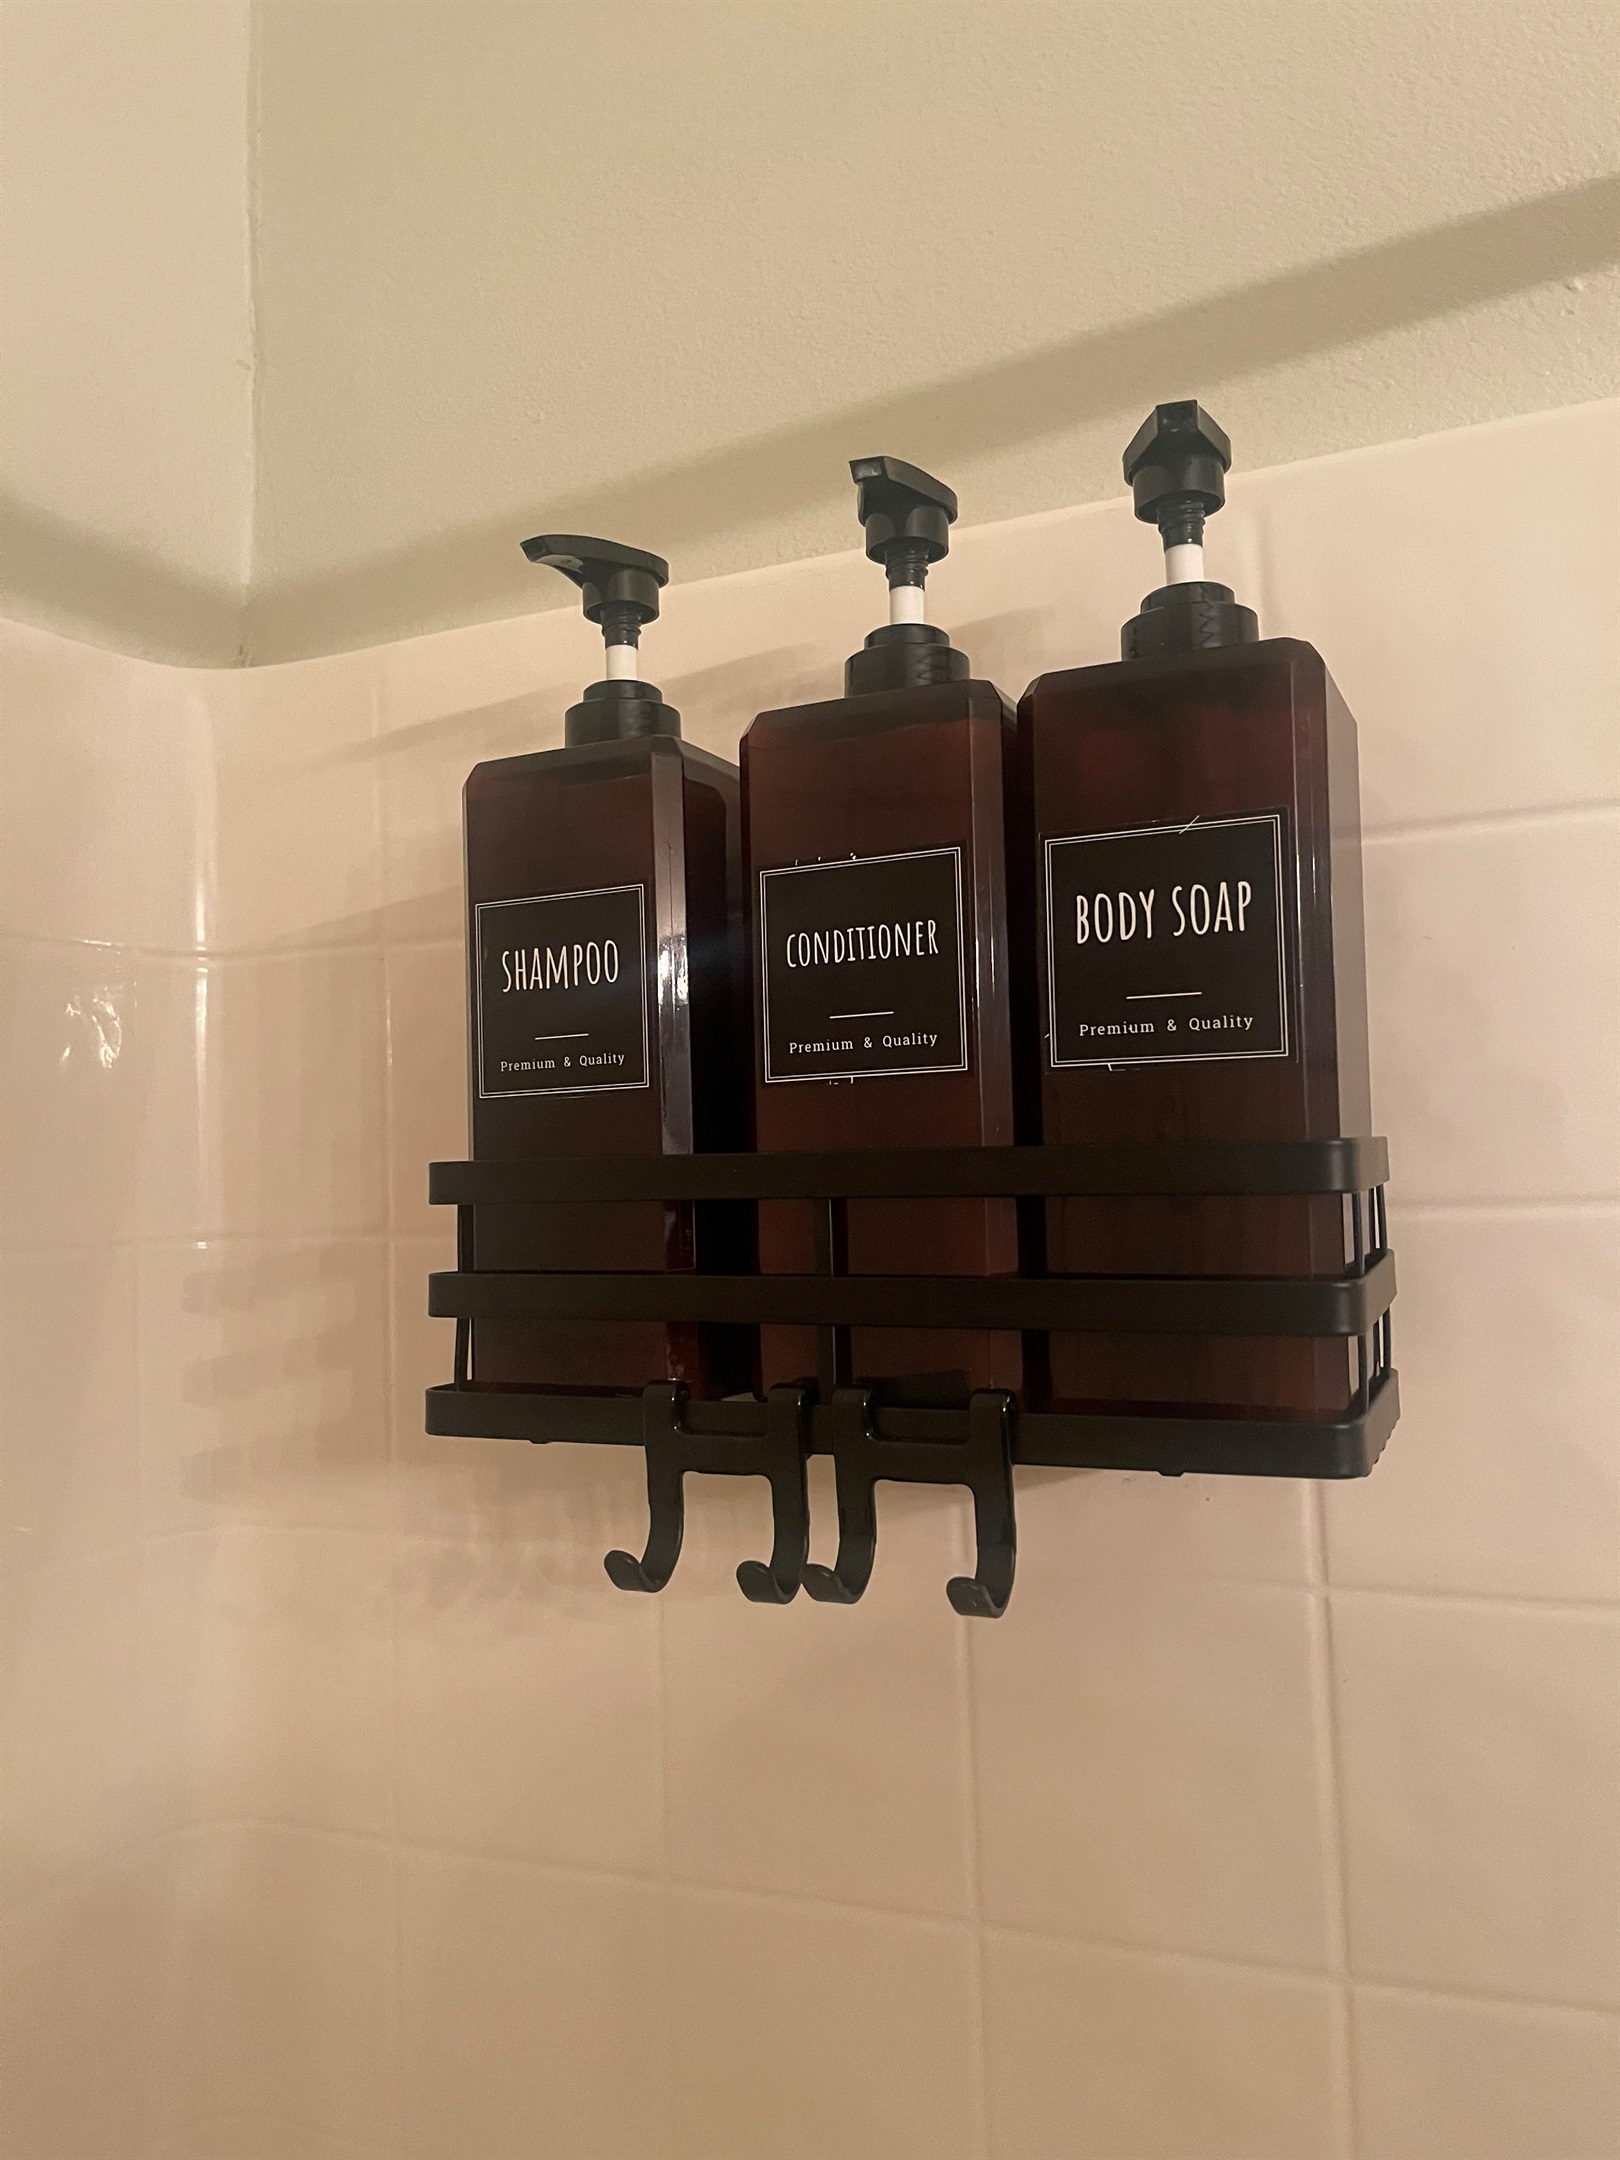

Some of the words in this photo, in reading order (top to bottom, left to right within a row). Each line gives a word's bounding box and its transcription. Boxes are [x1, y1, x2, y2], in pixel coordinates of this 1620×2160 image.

[1076, 888, 1155, 945] BODY
[1171, 880, 1252, 937] SOAP
[786, 919, 939, 969] CONDITIONER
[501, 939, 620, 993] SHAMPOO
[789, 1039, 854, 1054] Premium
[863, 1036, 873, 1049] &
[882, 1032, 938, 1049] Quality
[1079, 1021, 1155, 1037] Premium
[1166, 1018, 1177, 1032] &
[1188, 1014, 1254, 1032] Quality
[500, 1058, 556, 1072] Premium
[563, 1056, 572, 1068] &
[579, 1052, 626, 1068] Quality
